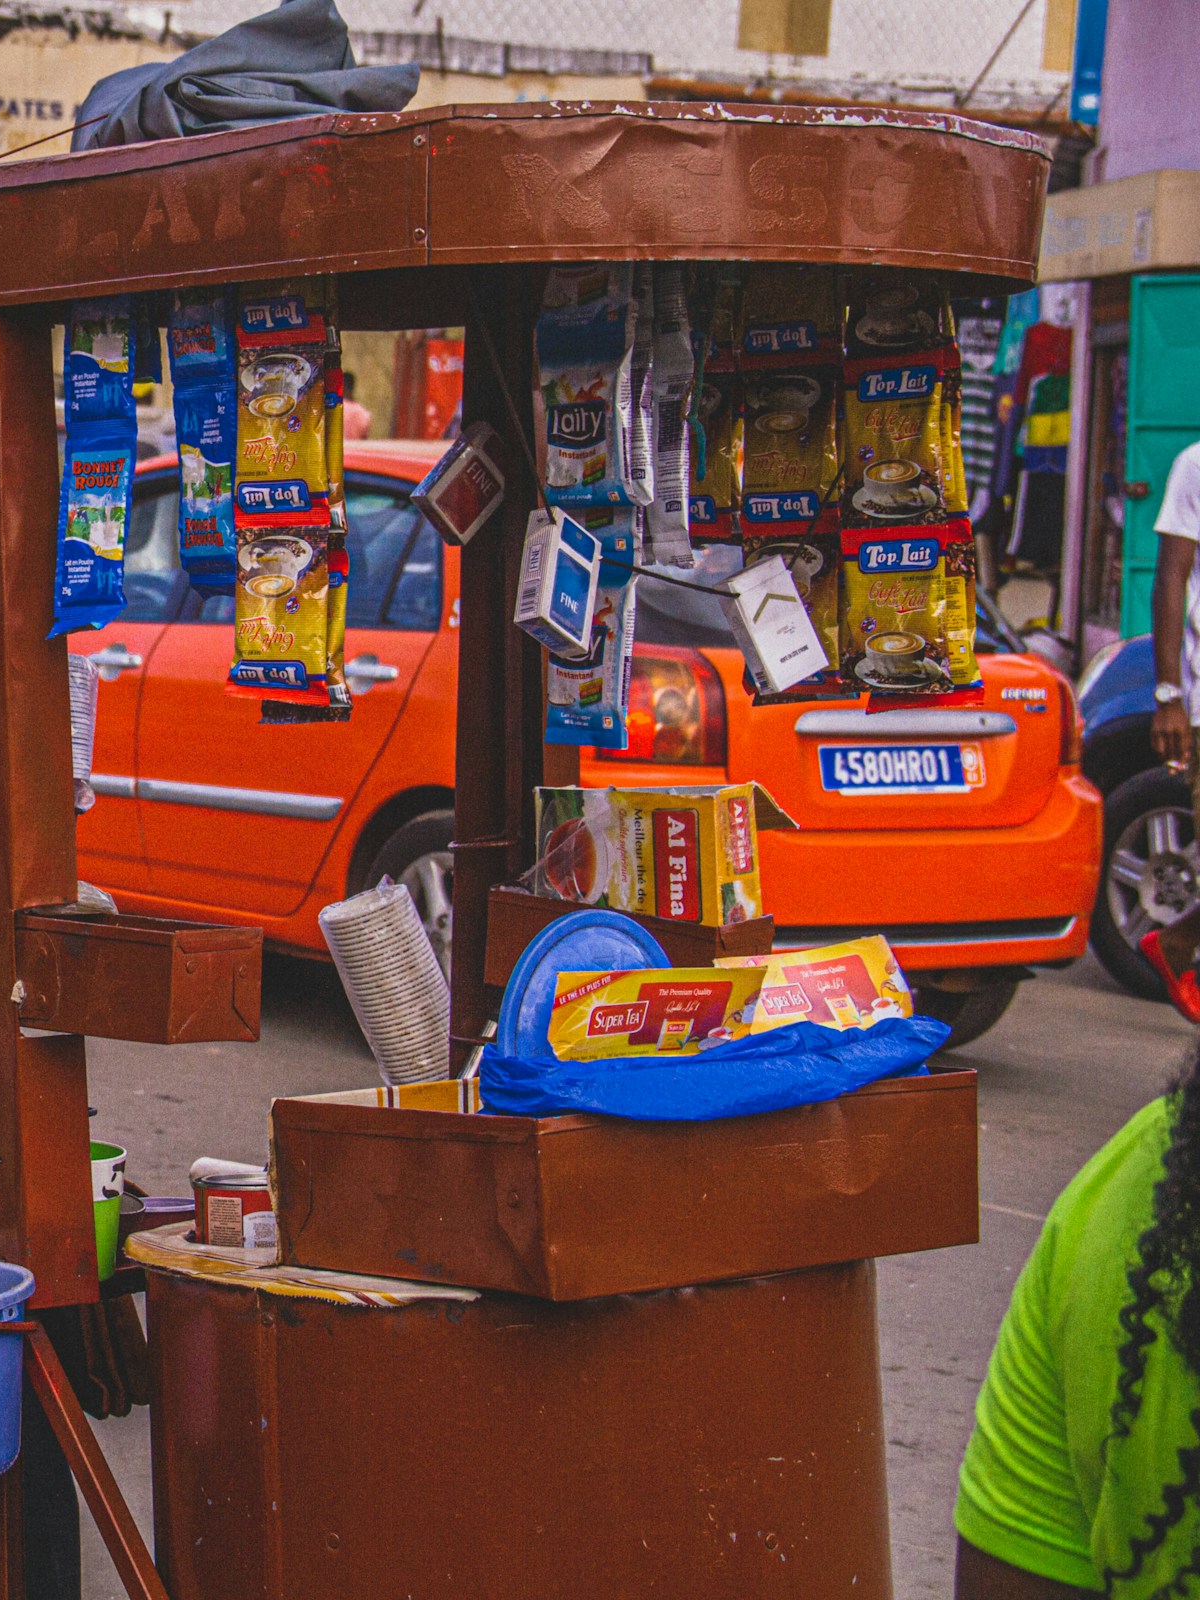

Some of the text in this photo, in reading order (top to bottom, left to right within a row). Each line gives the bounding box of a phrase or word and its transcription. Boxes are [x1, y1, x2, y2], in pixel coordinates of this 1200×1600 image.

[898, 370, 928, 393] Lait
[552, 408, 602, 439] Laity
[72, 458, 126, 476] BONNET
[75, 474, 120, 491] ROUGE
[466, 461, 496, 498] FINE
[241, 486, 275, 509] Lait
[748, 497, 781, 519] Lait
[900, 543, 932, 566] Lait
[560, 592, 580, 615] FINE
[834, 749, 951, 784] 4580HR01
[633, 808, 645, 863] Meilleur
[667, 815, 688, 917] Al Fina
[637, 888, 646, 903] de
[559, 995, 567, 1005] LE
[578, 986, 586, 996] LE
[586, 979, 601, 992] PLUS
[693, 988, 713, 996] Quality
